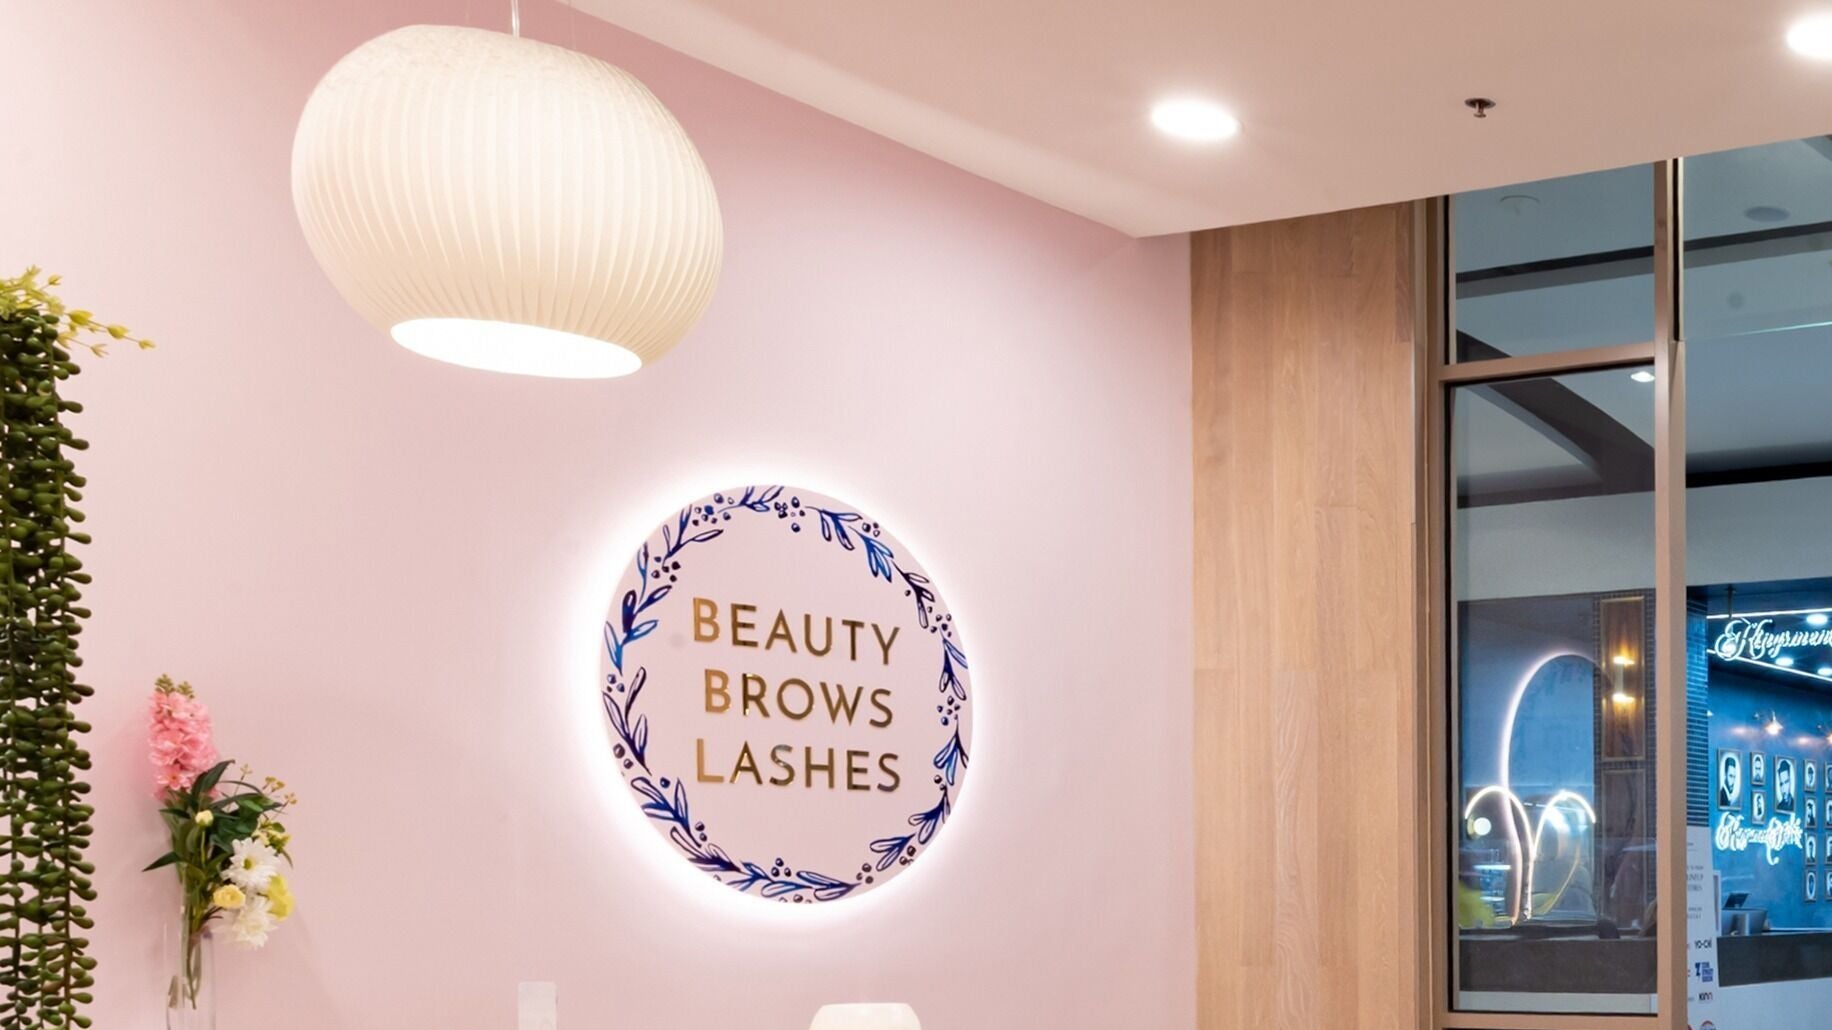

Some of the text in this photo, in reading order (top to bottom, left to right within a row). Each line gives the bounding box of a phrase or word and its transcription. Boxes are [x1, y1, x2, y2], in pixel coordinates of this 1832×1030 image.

[692, 597, 901, 666] BEAUTY
[703, 668, 895, 729] BROWS
[695, 738, 902, 793] LASHES
